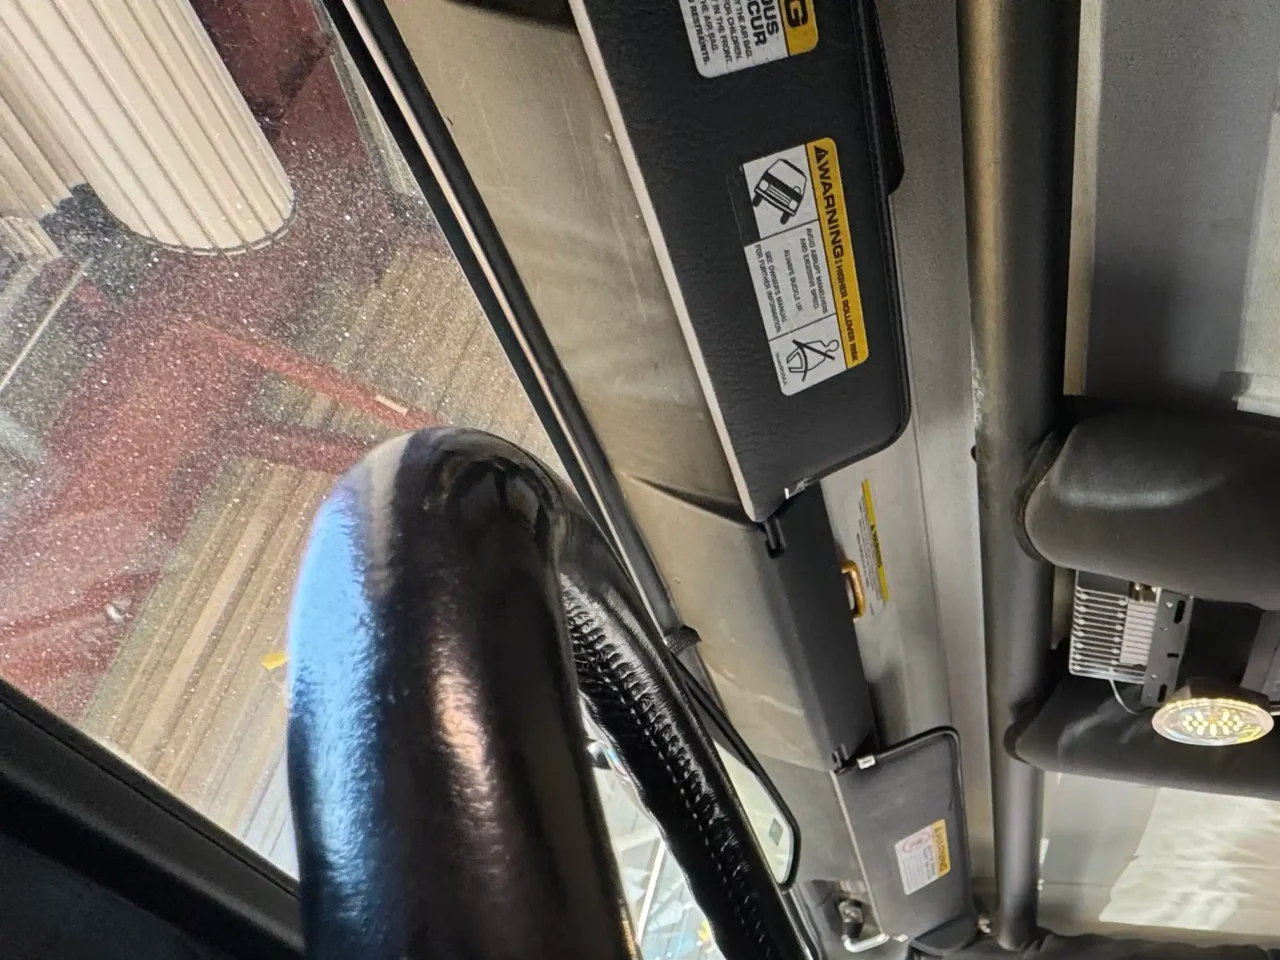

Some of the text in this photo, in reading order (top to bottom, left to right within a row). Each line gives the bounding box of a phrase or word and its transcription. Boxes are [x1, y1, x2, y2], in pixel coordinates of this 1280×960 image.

[703, 15, 712, 30] AIR
[712, 4, 720, 14] IN
[716, 16, 724, 33] THE
[736, 6, 744, 22] THE
[739, 25, 747, 38] AIR
[806, 228, 814, 247] AVOID
[810, 249, 820, 273] ABRUPT
[816, 160, 842, 263] WARNING:
[836, 264, 847, 297] HIGHER
[842, 299, 854, 341] ROLLOVER
[758, 259, 770, 289] FURTHER
[783, 249, 794, 275] ALWAYS
[790, 276, 799, 300] BUCKLE
[776, 296, 787, 322] MANUAL
